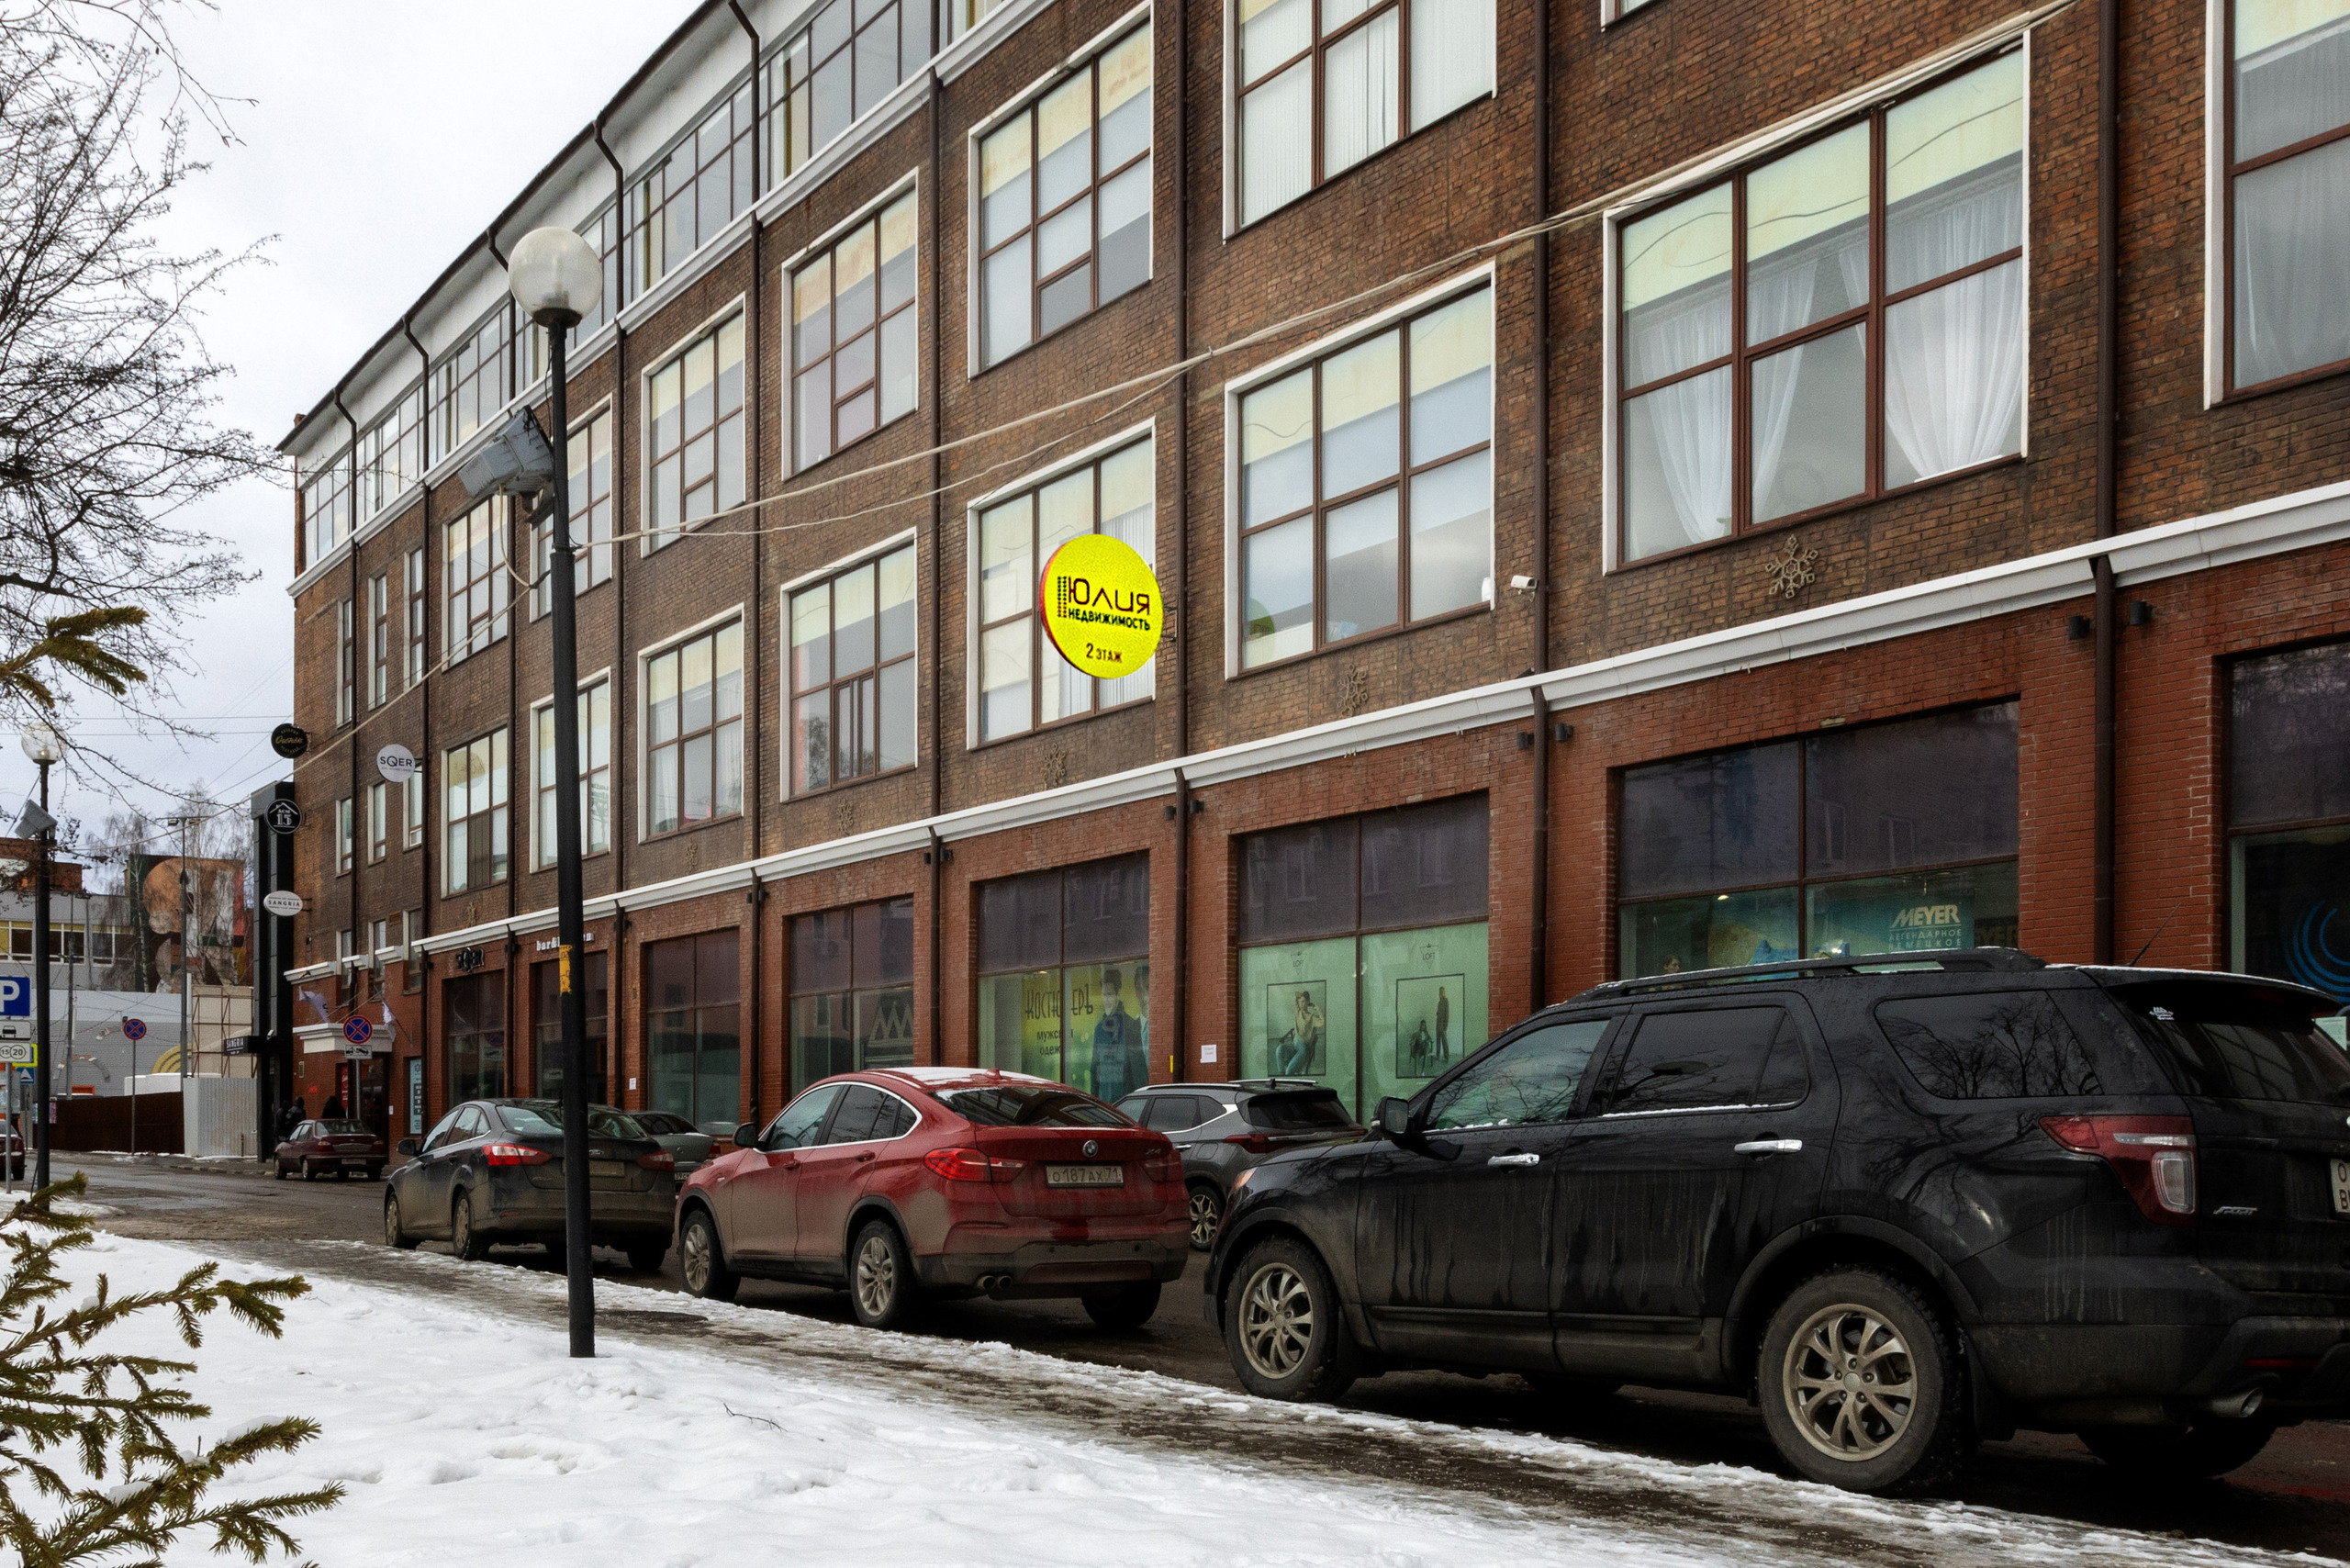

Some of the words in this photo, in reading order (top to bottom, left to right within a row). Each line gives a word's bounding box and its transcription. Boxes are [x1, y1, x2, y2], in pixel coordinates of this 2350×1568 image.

[1068, 608, 1150, 632] НЕДВИЖИМОСТЬ
[1086, 642, 1094, 658] 2
[380, 756, 413, 767] SQER
[276, 813, 292, 826] 15
[1891, 904, 1961, 928] MEYER
[0, 980, 20, 1013] P
